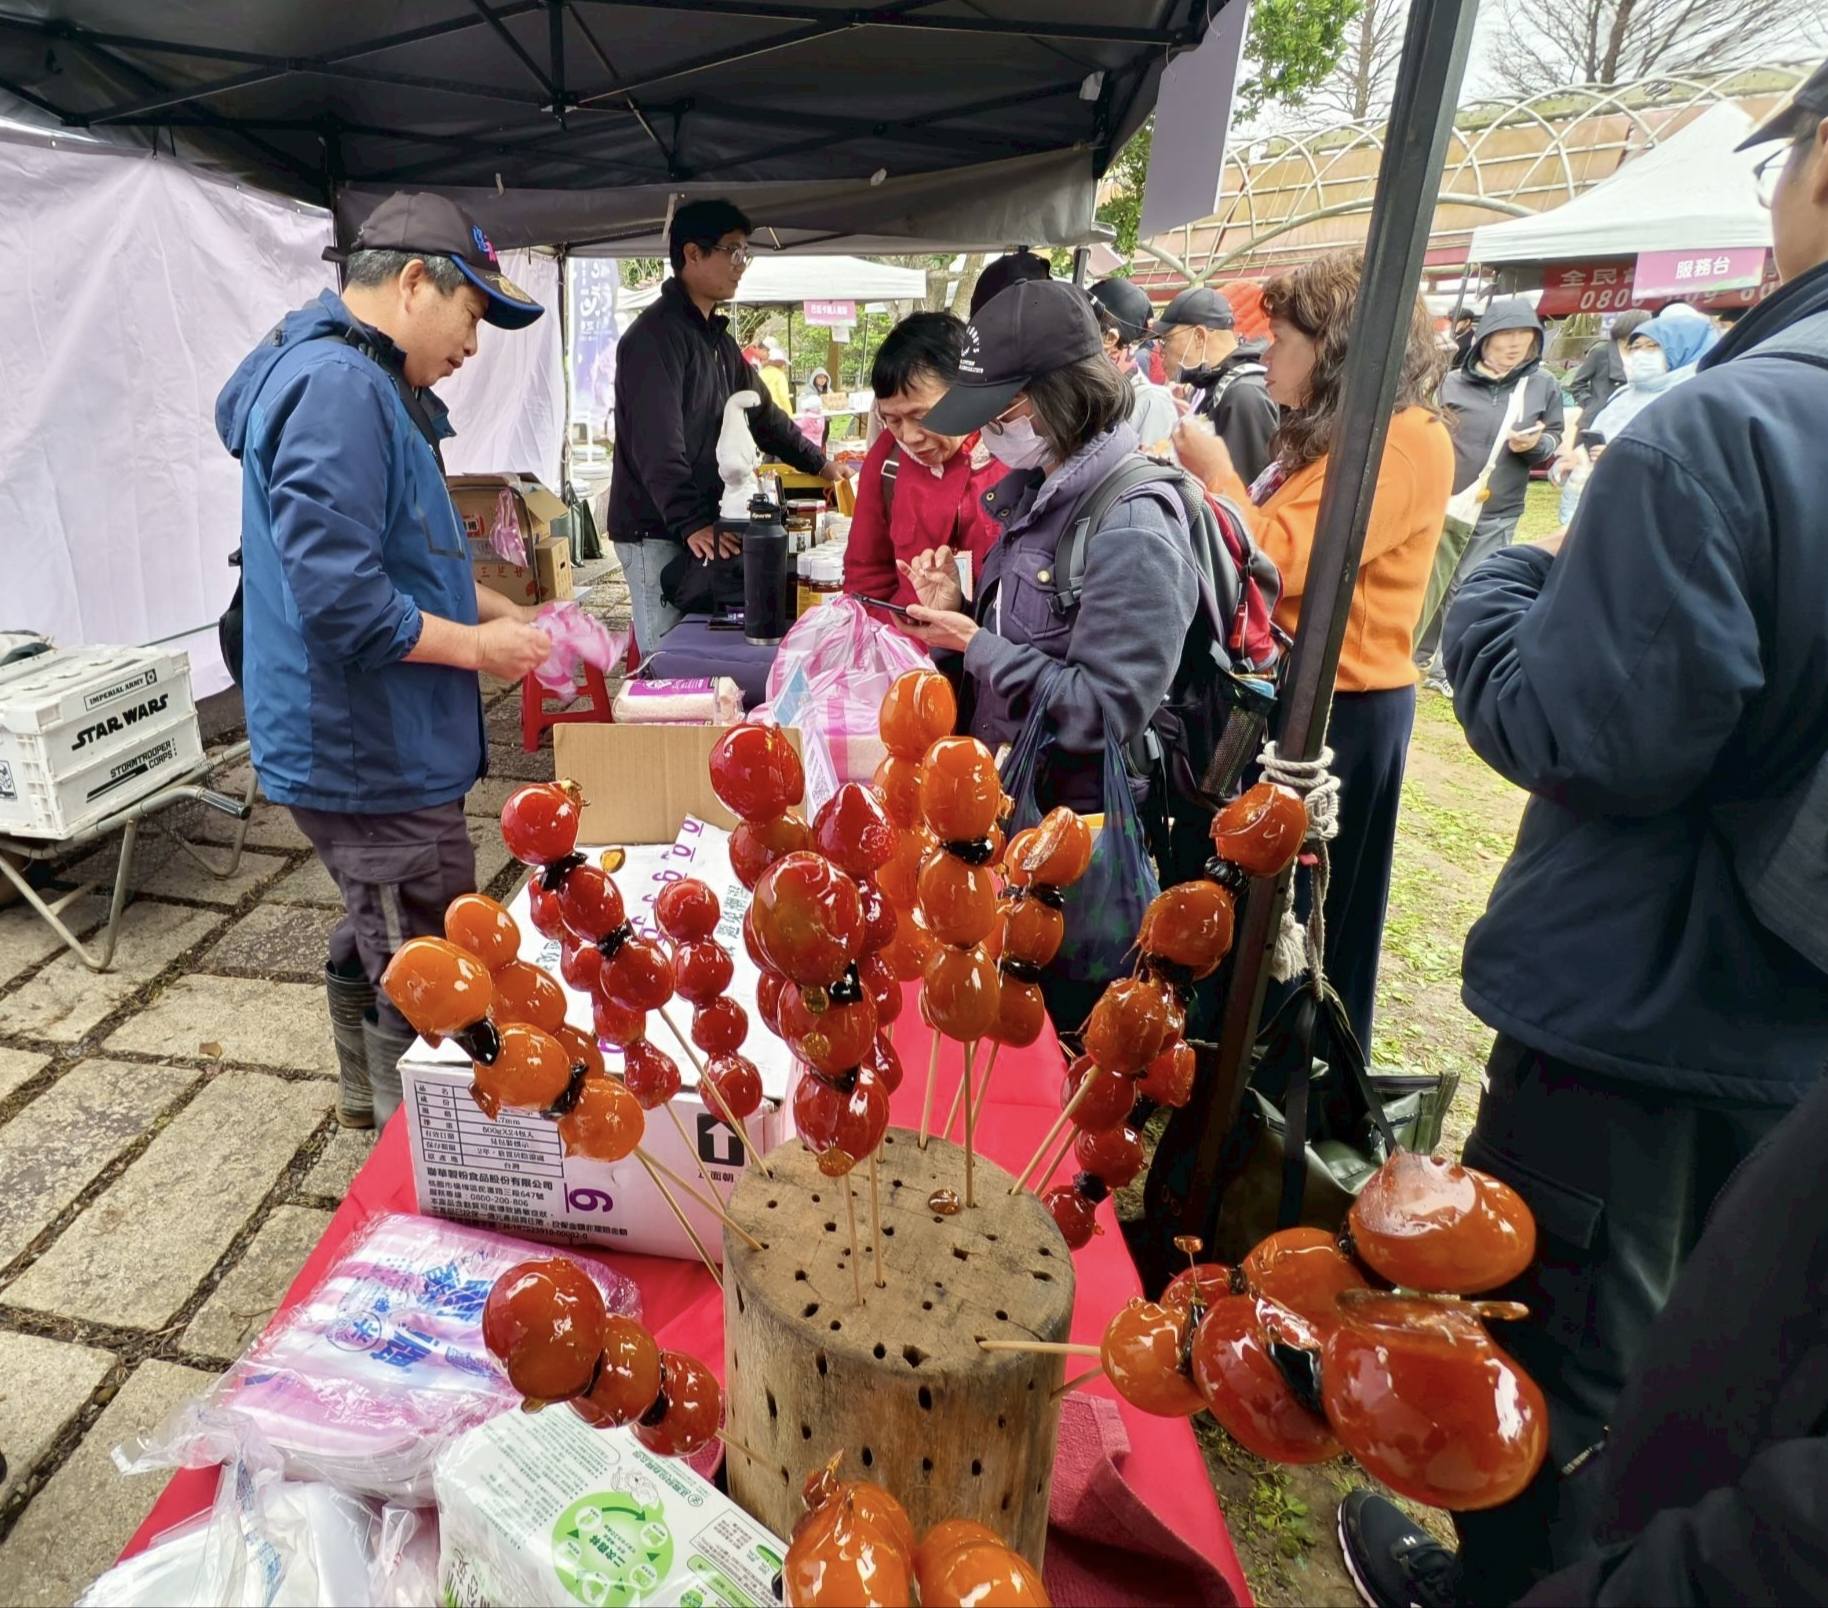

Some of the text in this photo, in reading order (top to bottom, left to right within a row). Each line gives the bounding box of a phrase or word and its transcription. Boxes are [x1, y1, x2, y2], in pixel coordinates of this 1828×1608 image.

[1675, 256, 1730, 280] 服務台
[89, 678, 144, 705] IMPERIAL ARMY
[71, 693, 168, 751] STAR WARS
[110, 740, 171, 778] STORMTROOPER
[148, 750, 173, 769] CORPS
